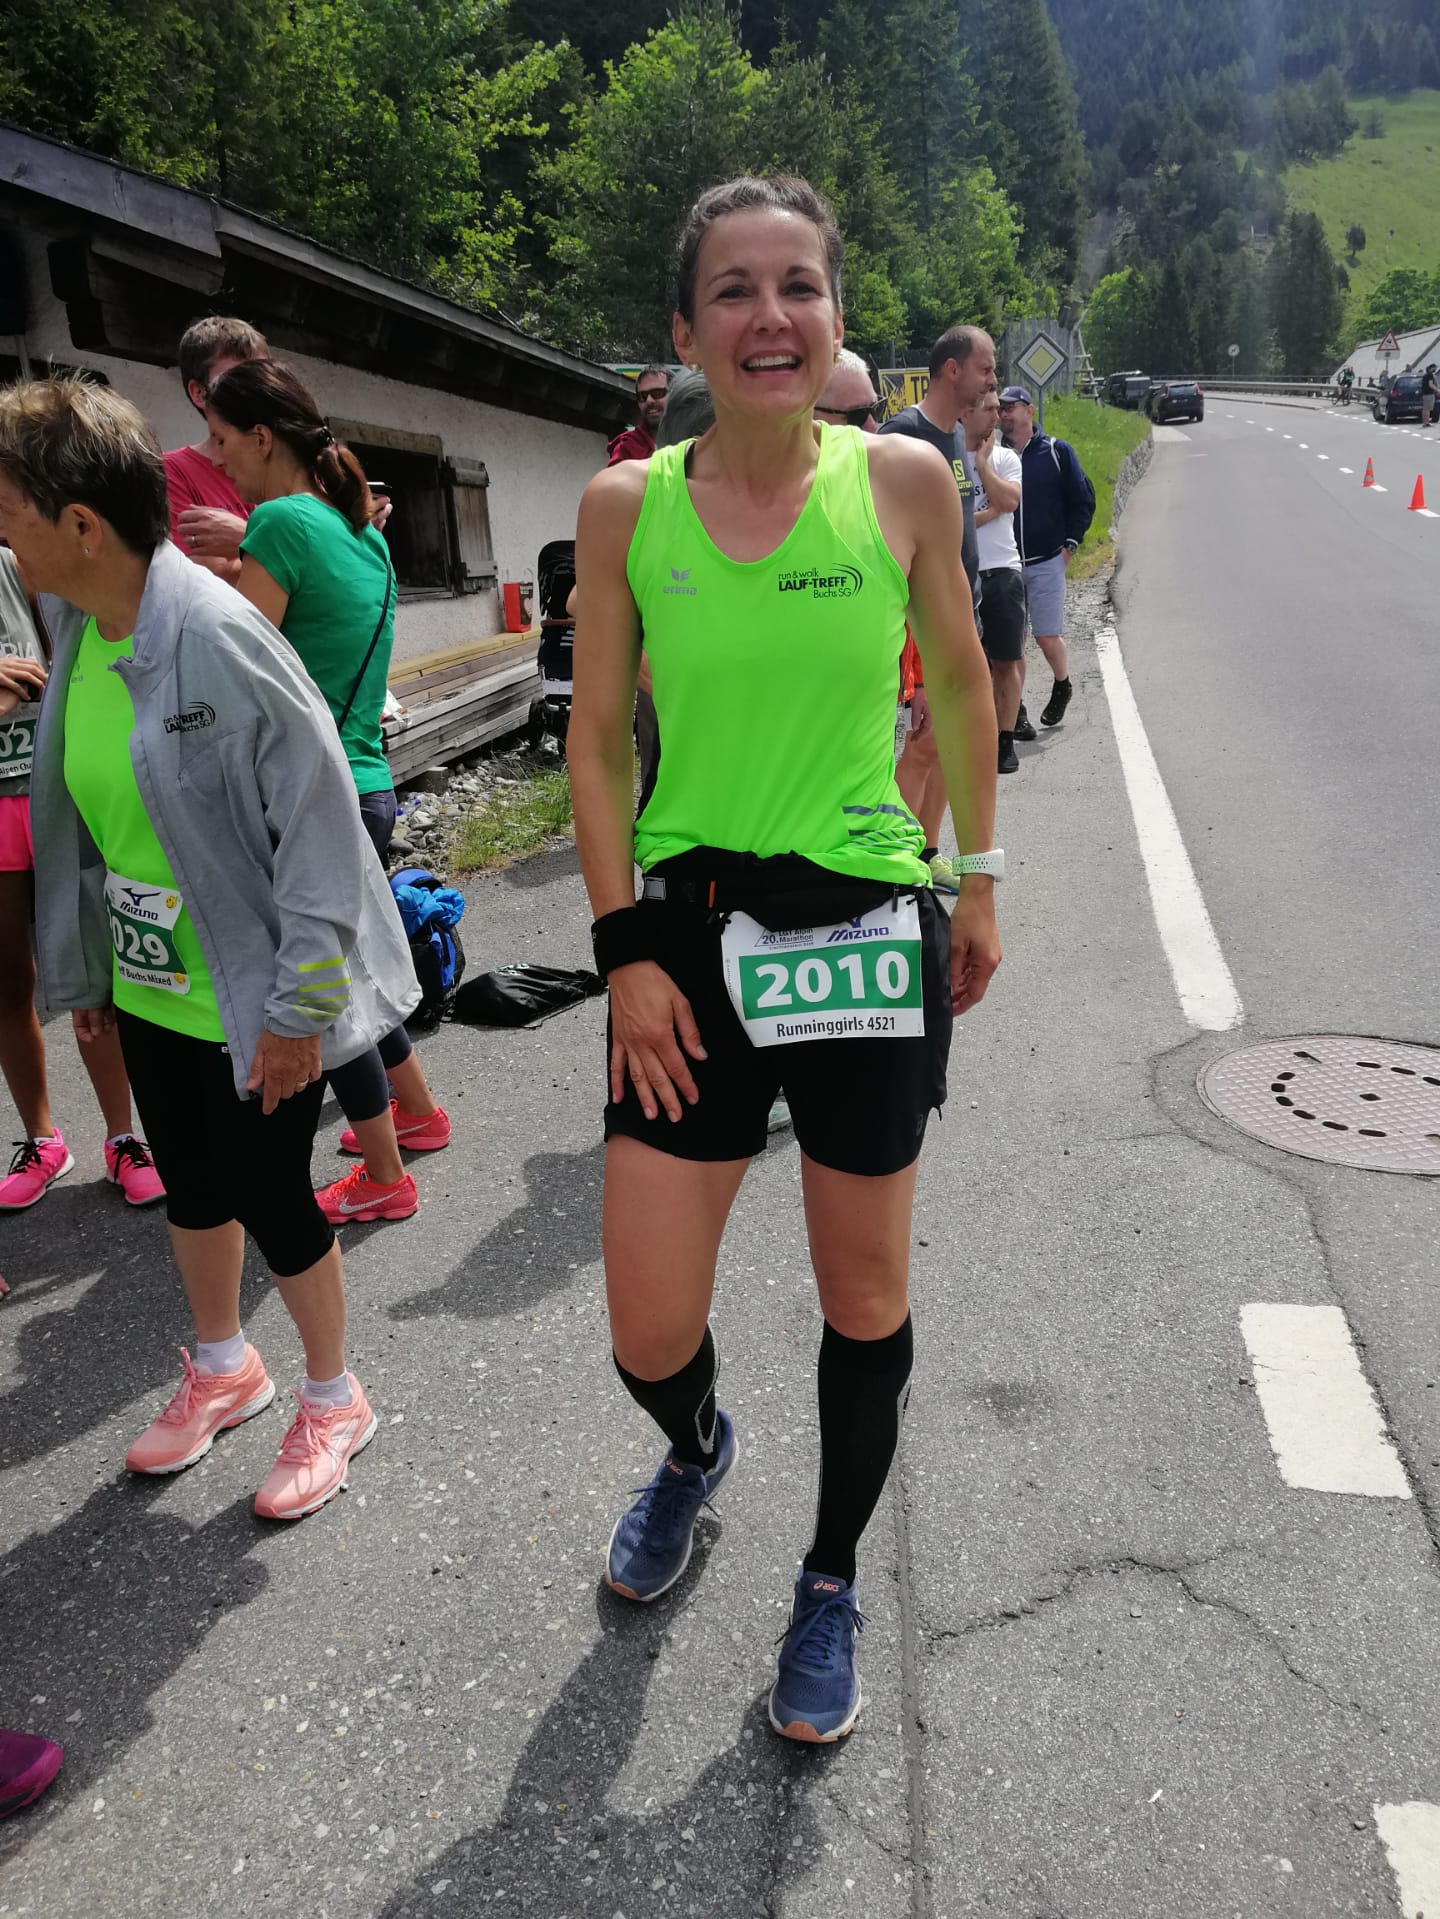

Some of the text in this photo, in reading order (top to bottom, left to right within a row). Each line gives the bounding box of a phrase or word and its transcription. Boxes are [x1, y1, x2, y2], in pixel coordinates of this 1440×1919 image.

[663, 585, 697, 595] erima
[778, 576, 847, 592] LAUF-TREFF
[813, 587, 852, 598] Buchs SG
[1, 641, 36, 659] RIA
[0, 727, 34, 757] 02
[112, 915, 169, 966] 029
[779, 934, 814, 943] Marathon
[147, 974, 172, 986] Mixed
[755, 951, 910, 1009] 2010
[776, 1016, 895, 1037] Runninggirls 4521
